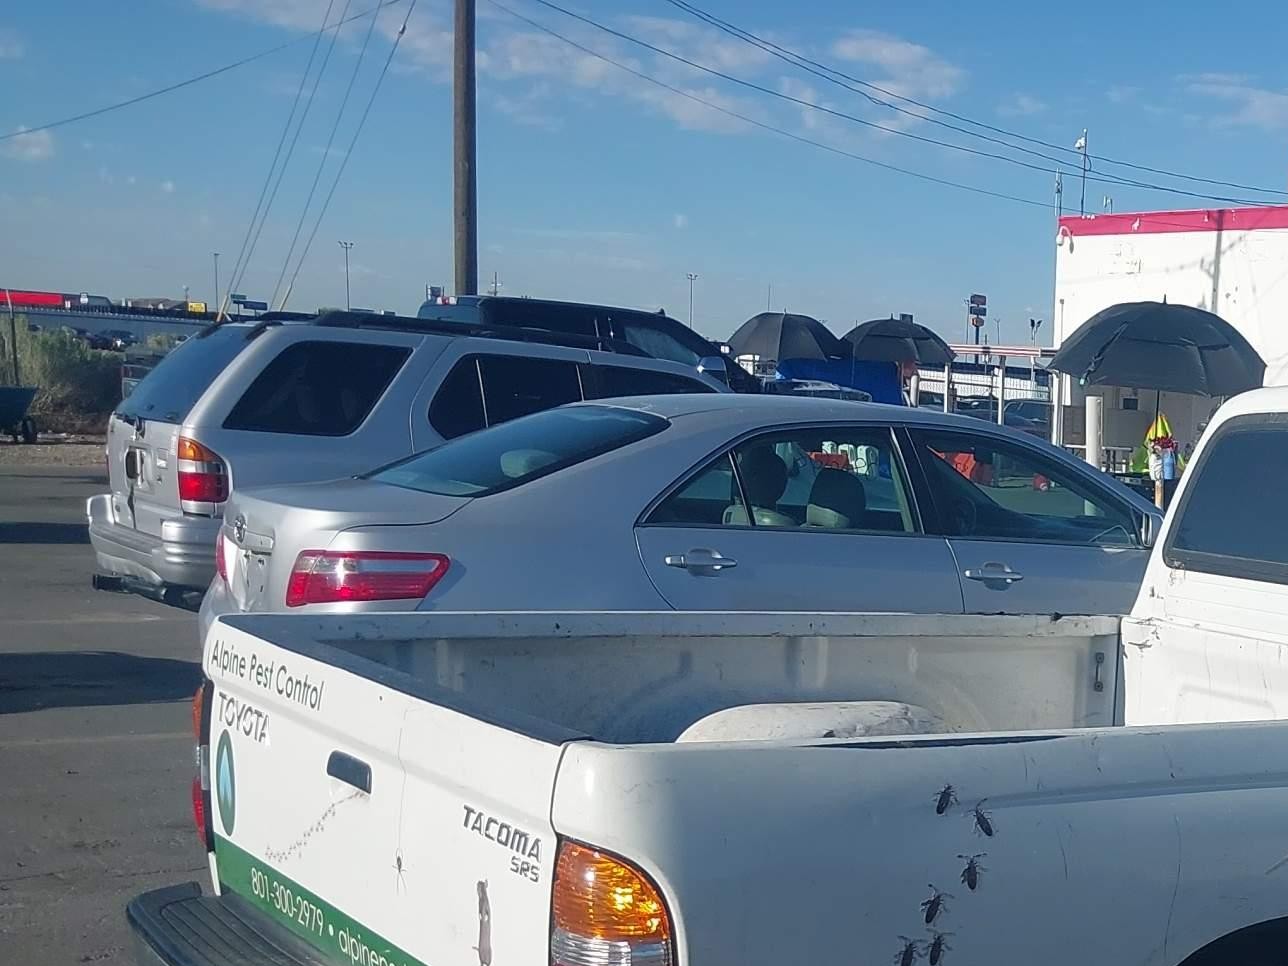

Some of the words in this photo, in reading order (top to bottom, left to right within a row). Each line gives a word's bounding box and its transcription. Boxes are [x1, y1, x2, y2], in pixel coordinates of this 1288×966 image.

[210, 639, 247, 679] Alpine
[249, 653, 274, 690] Pest
[276, 664, 325, 711] Control
[218, 691, 271, 744] TOYOTA
[462, 804, 542, 863] TACOMA
[251, 866, 325, 937] 801-300-2979
